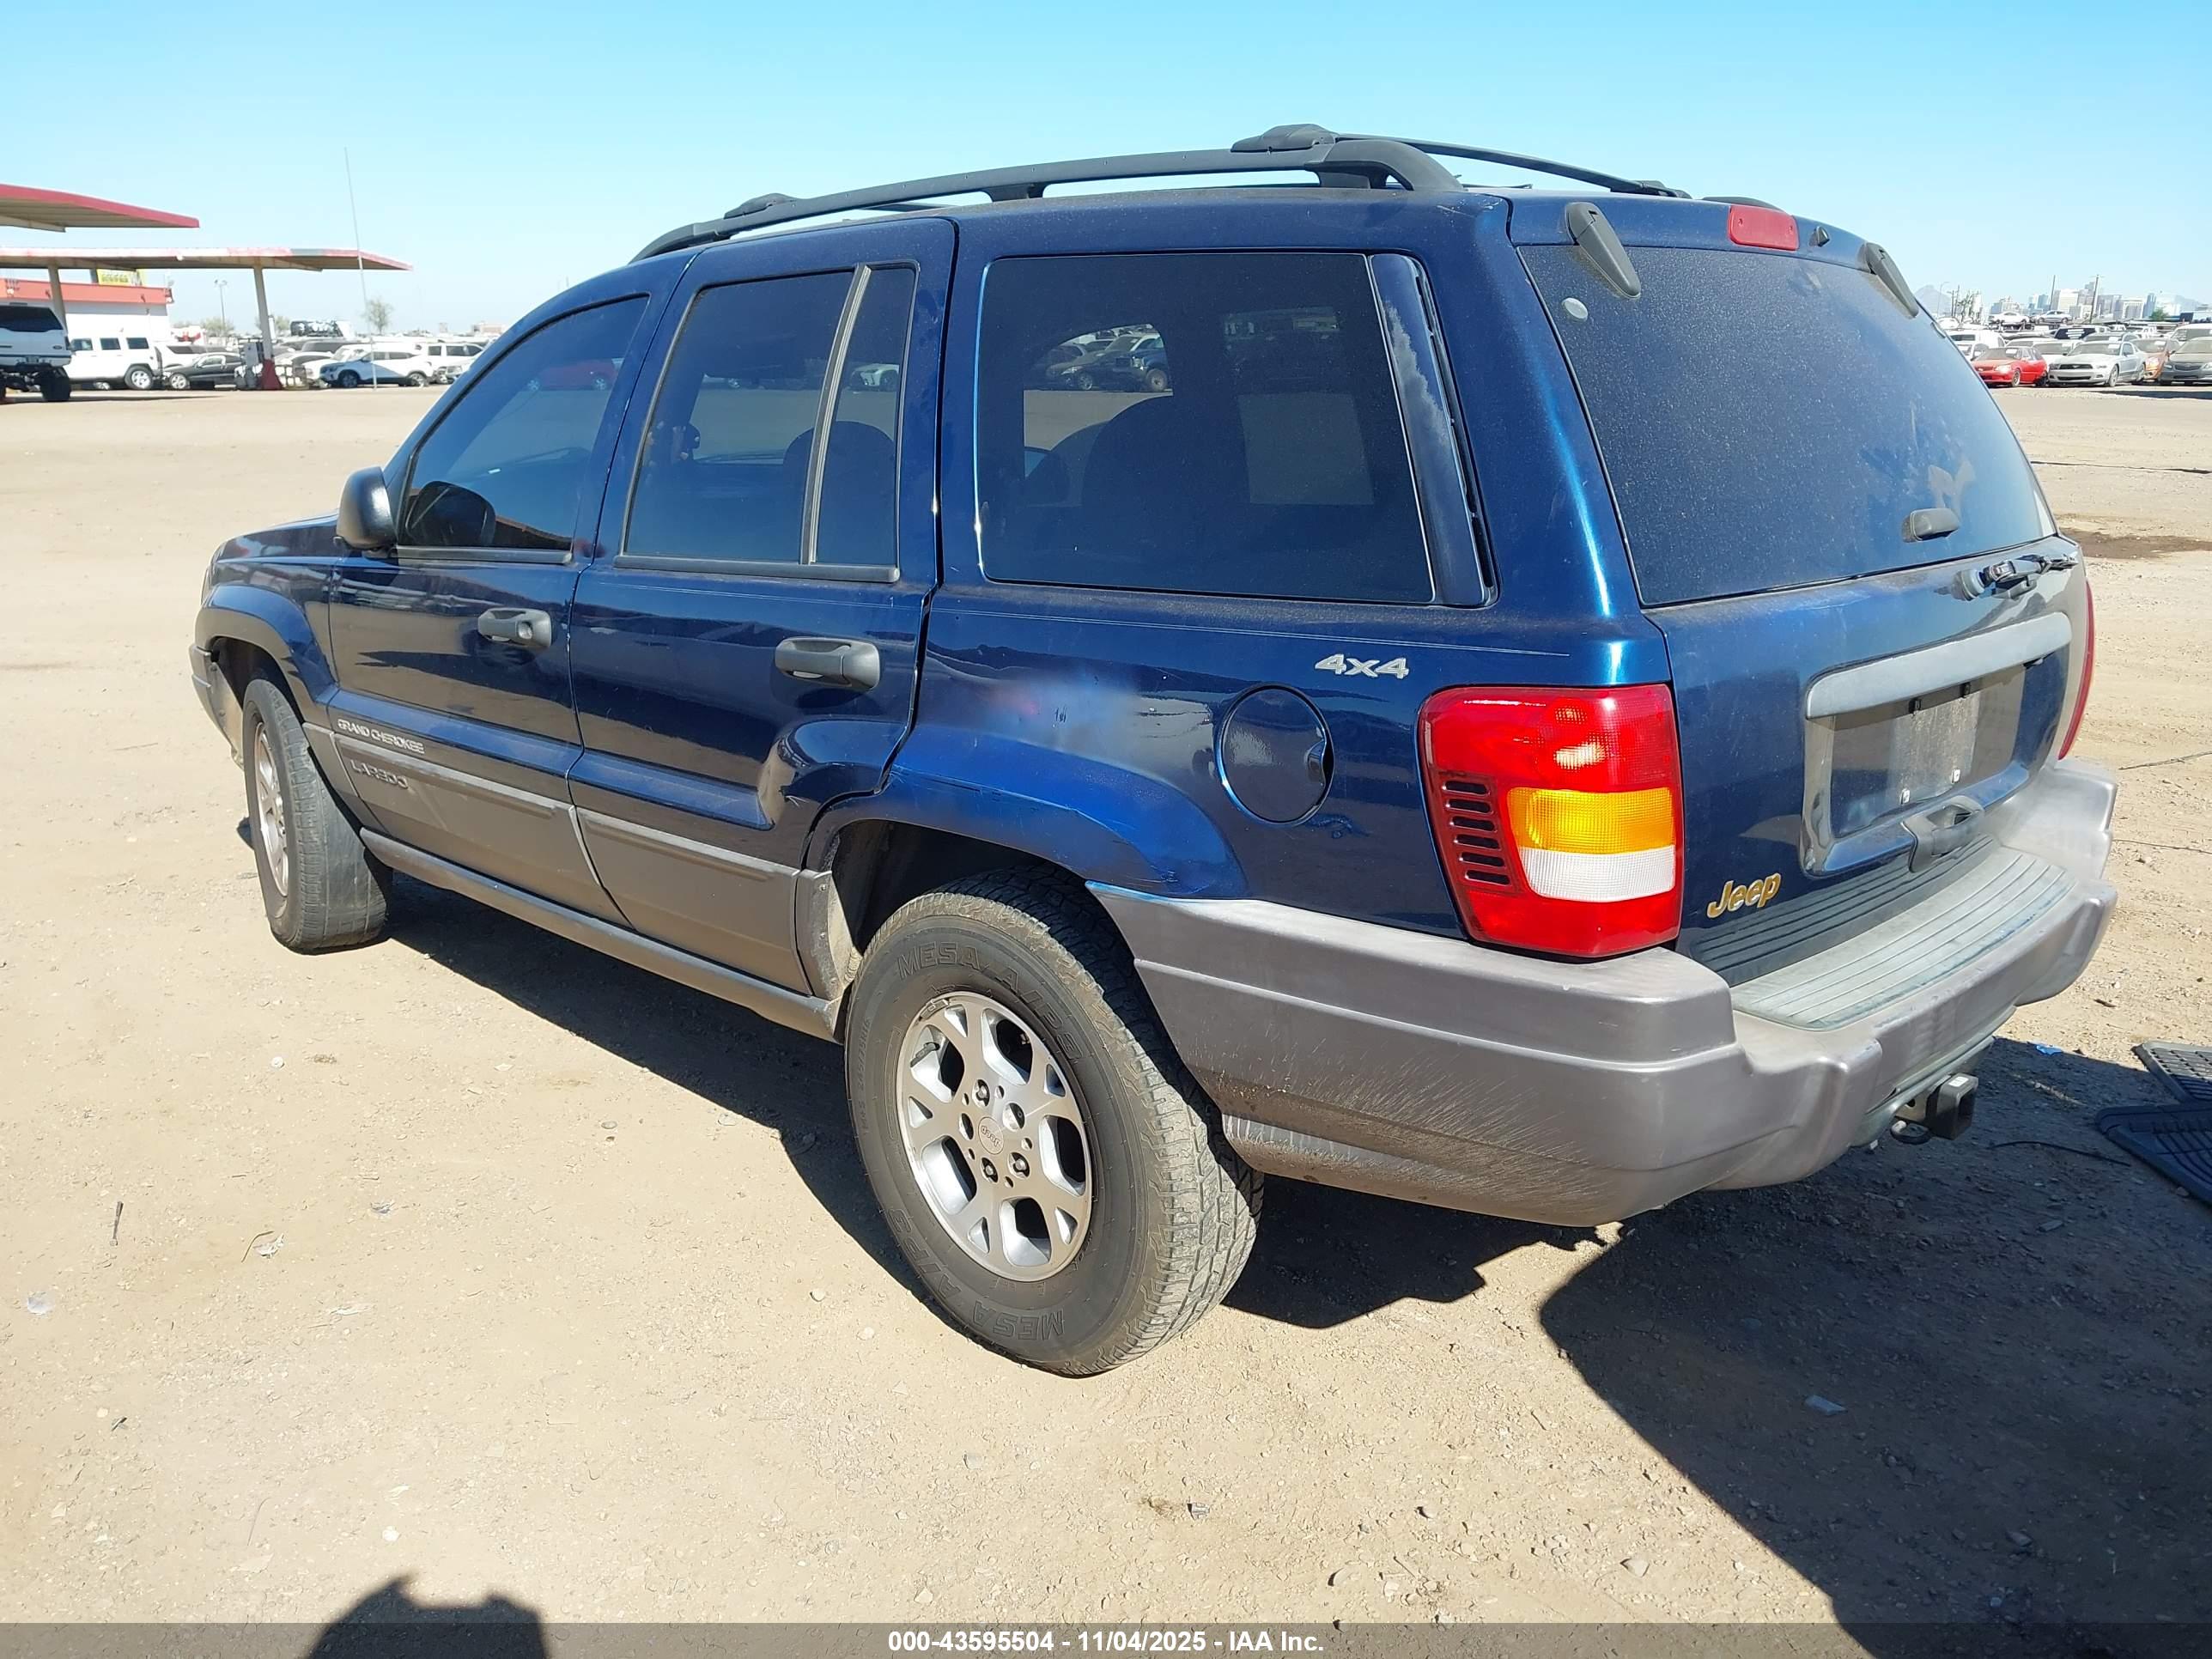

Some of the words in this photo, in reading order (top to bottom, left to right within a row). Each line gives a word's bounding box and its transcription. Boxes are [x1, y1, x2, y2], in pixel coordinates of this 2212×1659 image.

[337, 719, 370, 736] GRAND
[371, 729, 425, 754] CHEROKEE
[350, 759, 409, 789] LAREDO
[1706, 872, 1782, 919] Jeep
[897, 942, 981, 981] MESA
[981, 1126, 1001, 1147] Jeep
[972, 1300, 1064, 1340] MESA
